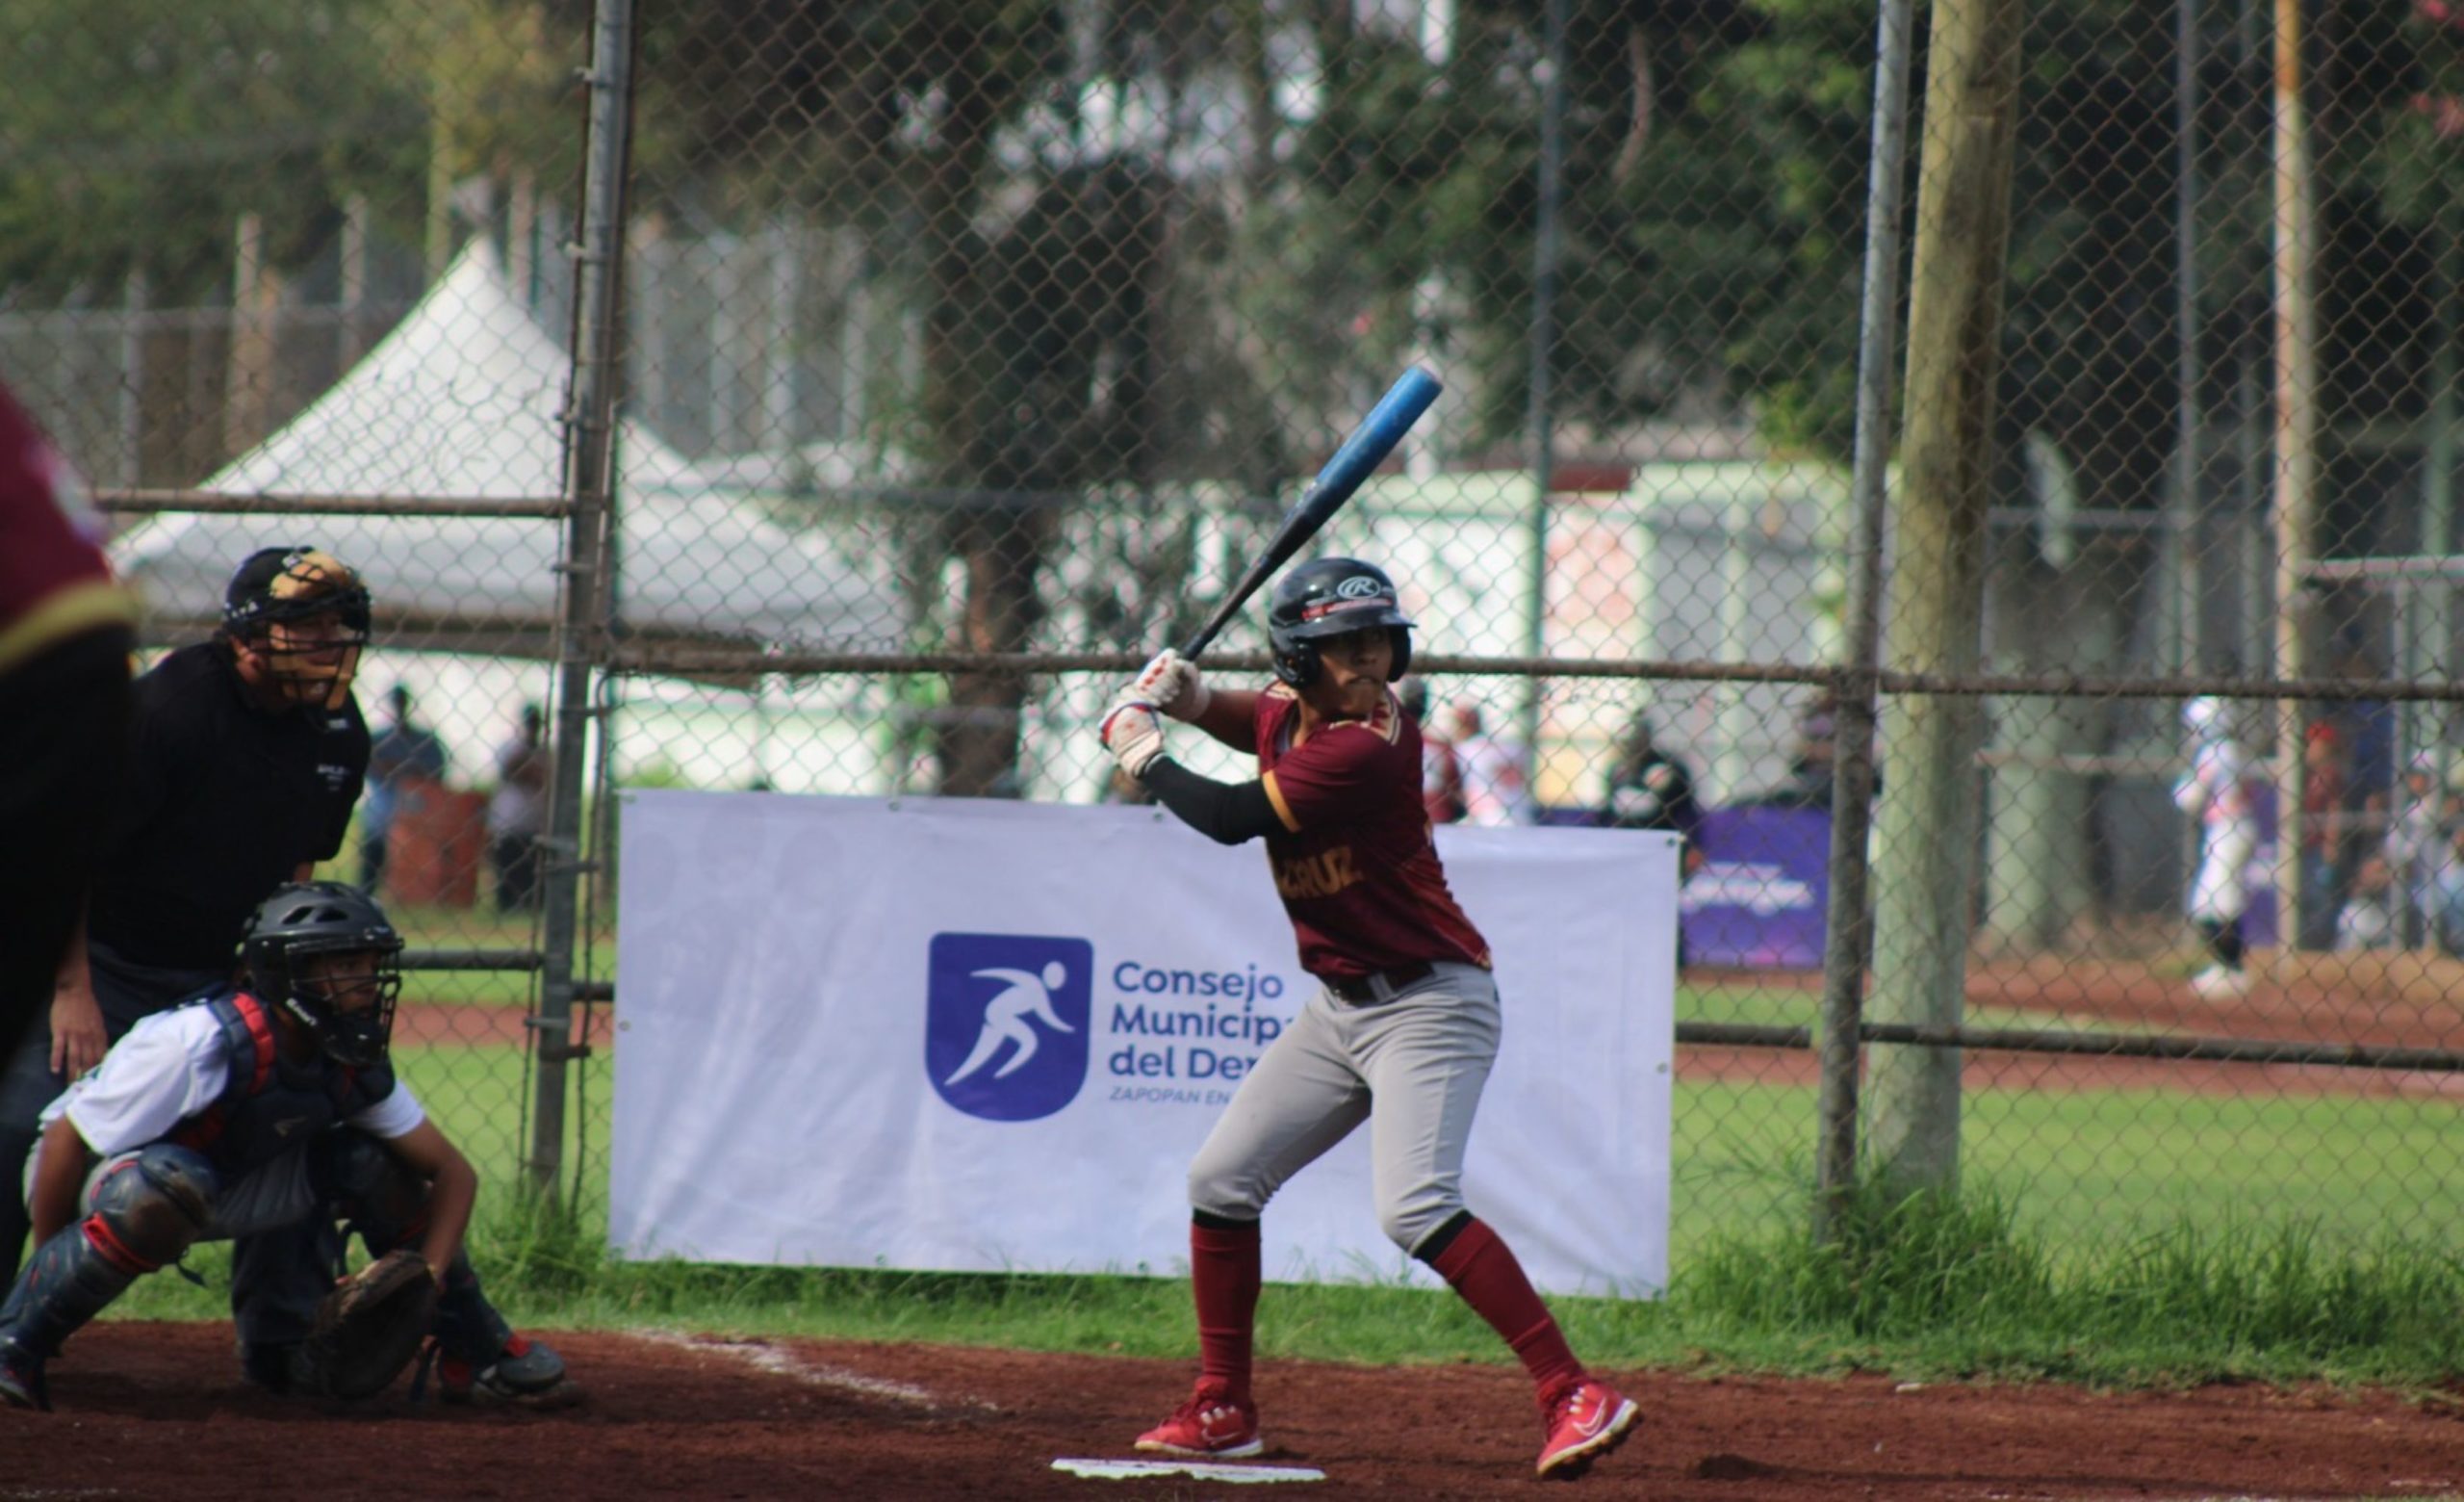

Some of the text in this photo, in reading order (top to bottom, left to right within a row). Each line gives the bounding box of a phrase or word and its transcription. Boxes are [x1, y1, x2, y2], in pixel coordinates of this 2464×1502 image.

[1113, 961, 1284, 1003] Consejo
[1110, 1002, 1294, 1047] Municip
[1109, 1044, 1176, 1077] del
[1109, 1085, 1231, 1105] ZAPOPAN EN
